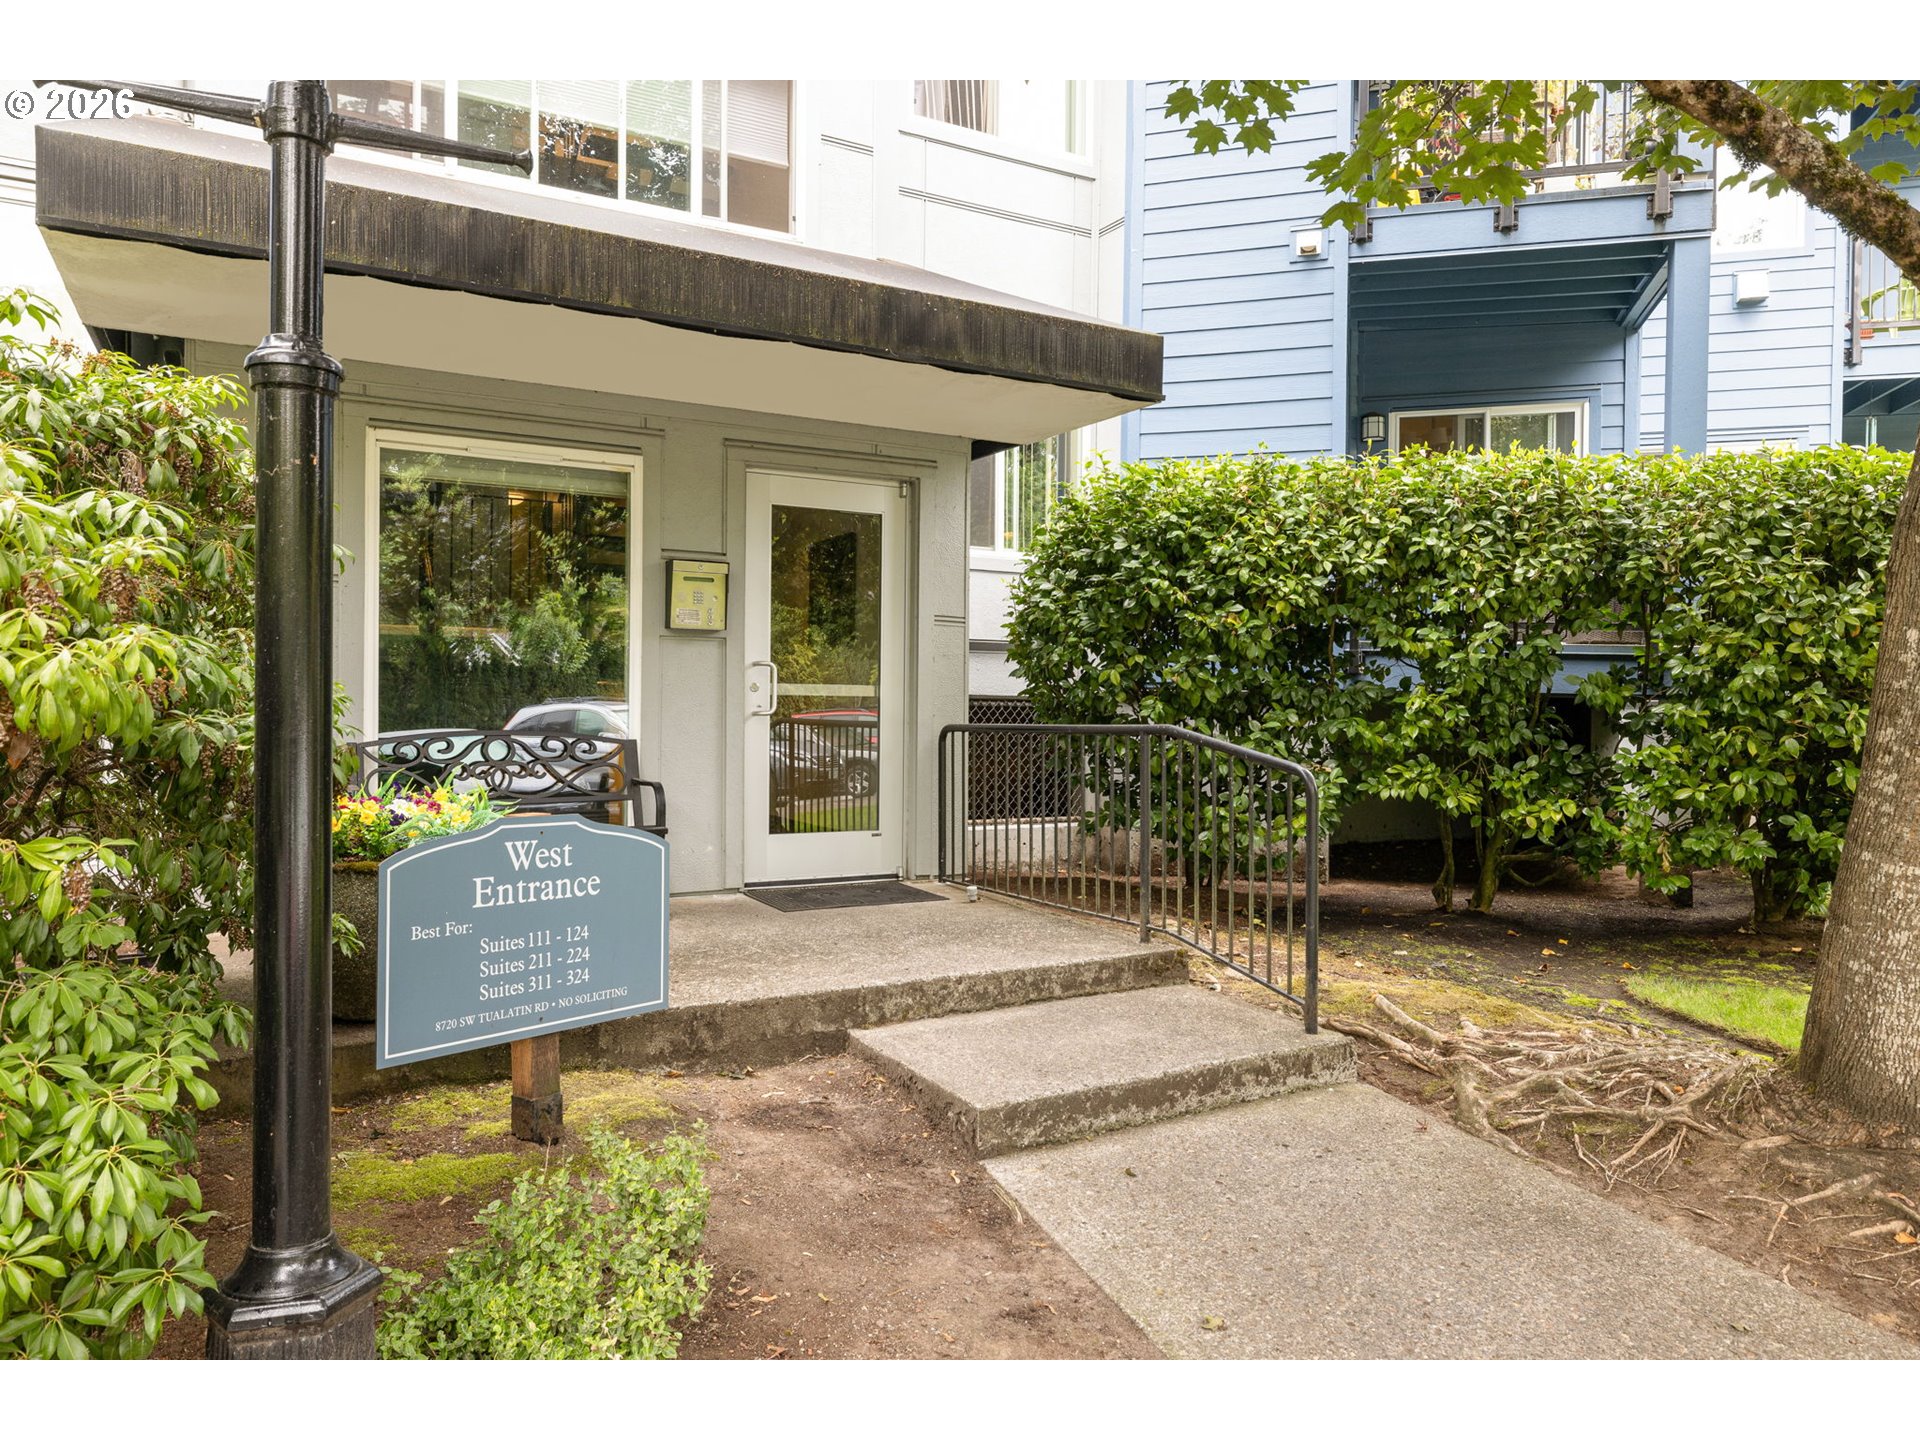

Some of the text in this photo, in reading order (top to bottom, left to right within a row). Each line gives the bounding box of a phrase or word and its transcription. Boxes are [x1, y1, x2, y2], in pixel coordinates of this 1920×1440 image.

[505, 839, 572, 871] West
[473, 875, 600, 908] Entrance
[411, 922, 472, 940] Best For:
[480, 938, 525, 954] Suites
[529, 930, 551, 947] 111
[566, 925, 589, 942] 124
[480, 961, 524, 977] Suites
[529, 953, 551, 969] 211
[567, 947, 590, 963] 224
[480, 984, 524, 1000] Suites
[529, 975, 551, 991] 311
[567, 968, 590, 985] 324
[436, 987, 627, 1031] 8720 SW TUALATIN RD NO SOLICITING
